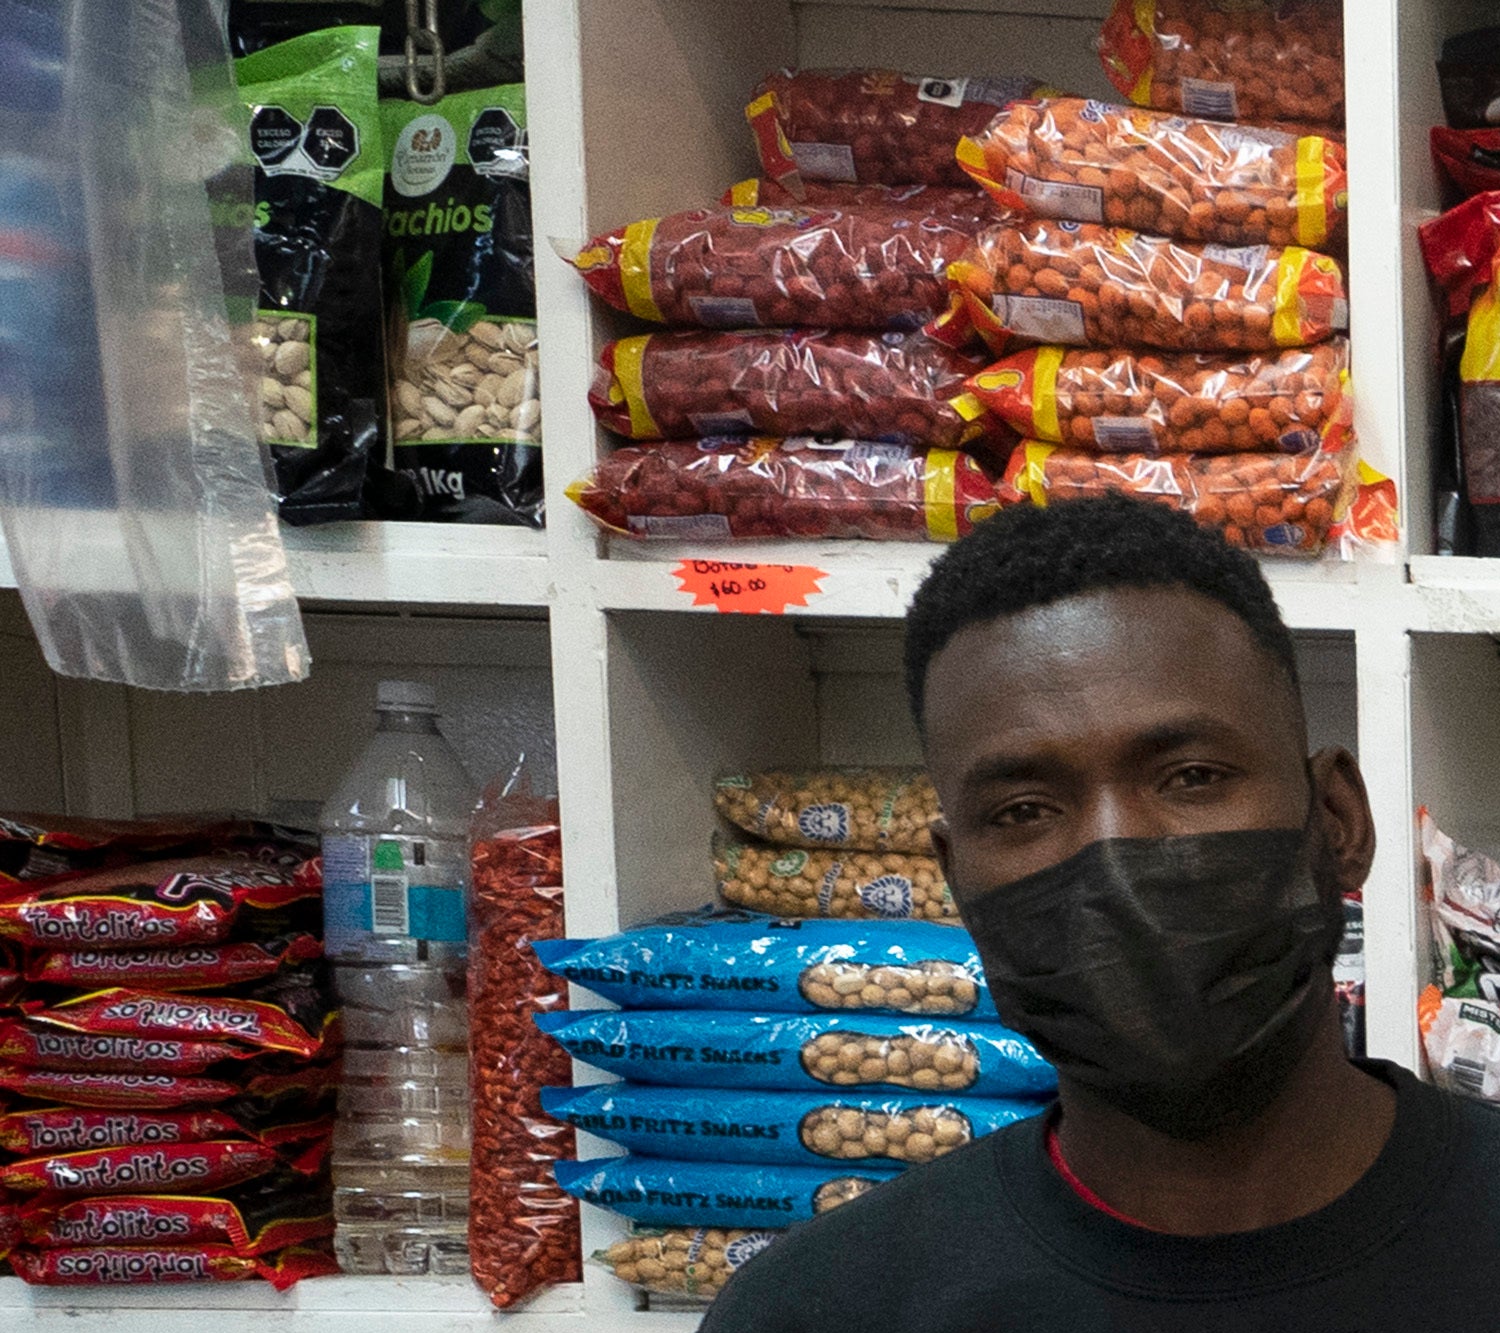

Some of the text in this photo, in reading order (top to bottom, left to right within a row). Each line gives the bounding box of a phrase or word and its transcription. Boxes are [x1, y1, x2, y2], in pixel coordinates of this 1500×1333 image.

[421, 466, 465, 500] 1Kg
[29, 911, 177, 942] Tortolitos
[700, 974, 781, 993] SNACKS
[102, 999, 262, 1037] Tortolitos
[701, 1048, 782, 1066] SNACKS
[27, 1116, 179, 1148] Tortolitos
[630, 1116, 697, 1136] FRITZ
[700, 1120, 781, 1140] SNACKS
[47, 1151, 209, 1190] Tortolitos
[715, 1193, 795, 1214] SNACKS
[56, 1254, 213, 1282] Tortolitos
